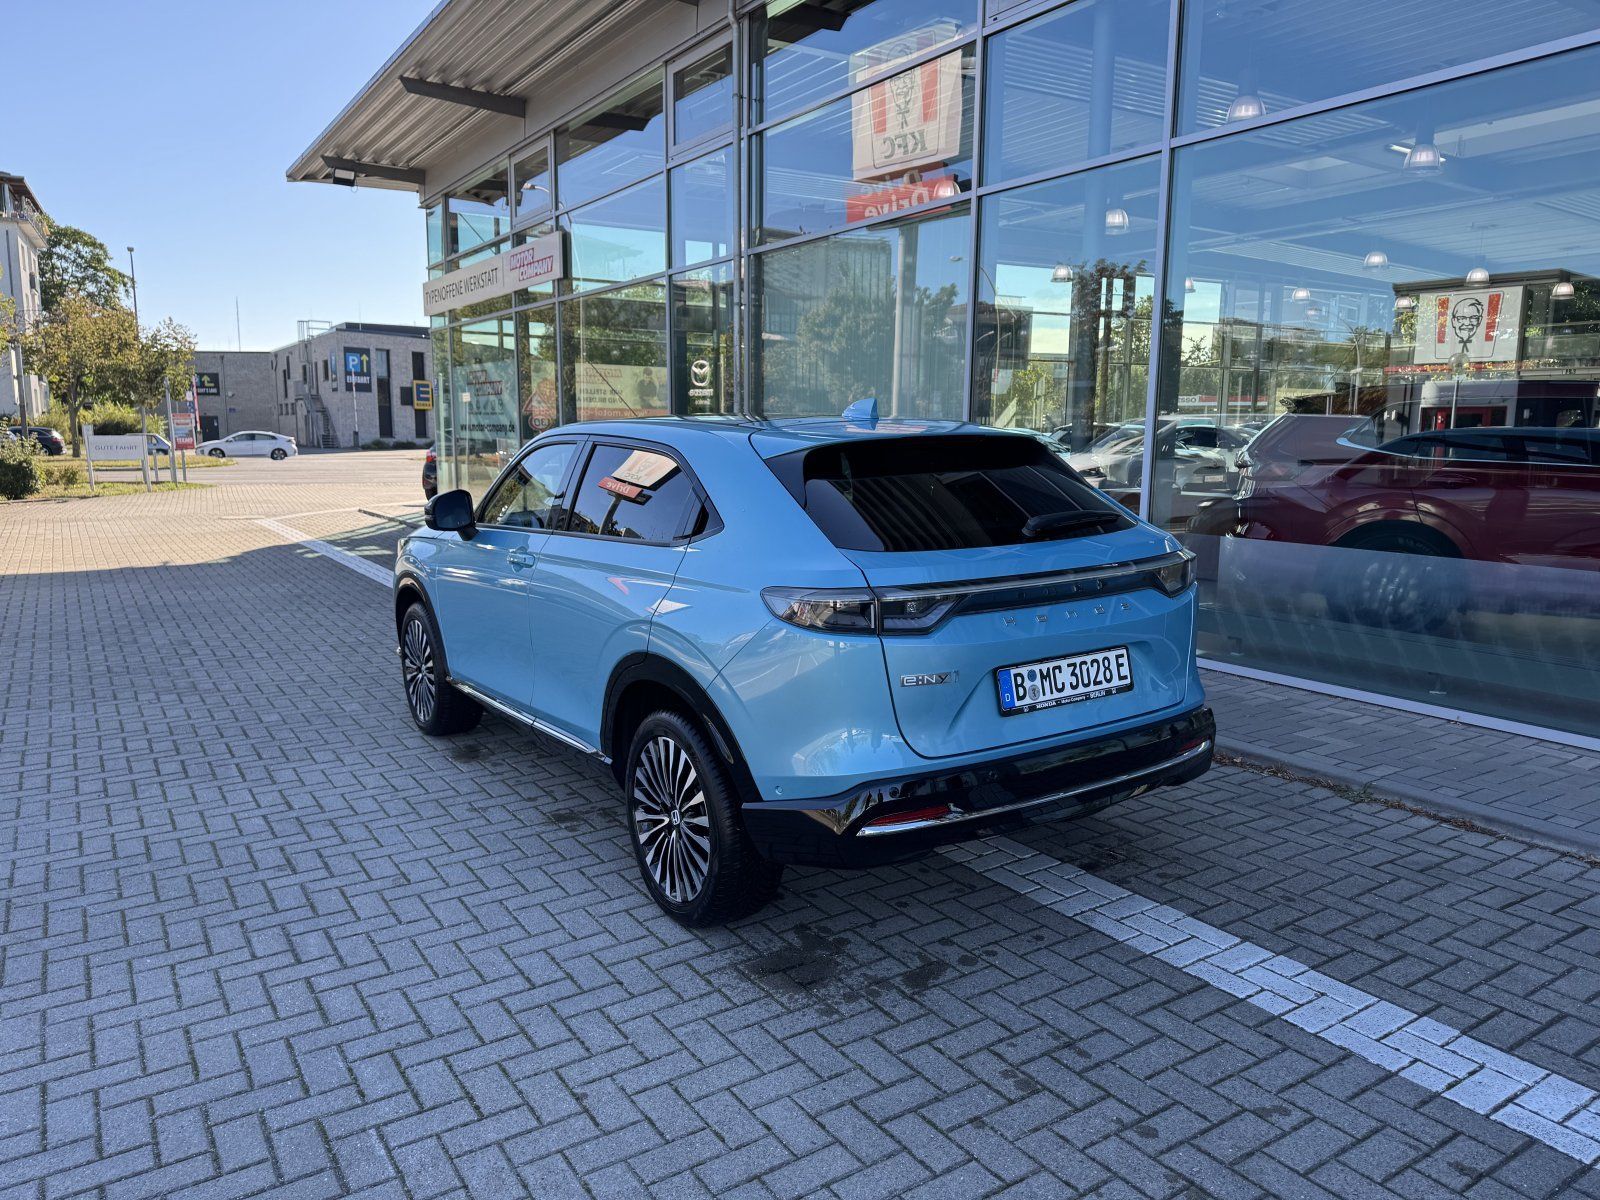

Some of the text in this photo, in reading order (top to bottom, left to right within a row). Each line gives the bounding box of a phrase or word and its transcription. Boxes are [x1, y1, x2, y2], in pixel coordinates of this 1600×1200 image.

[510, 248, 534, 271] MOTOR
[519, 255, 553, 282] COMPANY
[425, 267, 498, 306] TYPENOFFENE WERKSTATT
[349, 356, 358, 370] P
[1013, 672, 1028, 702] B
[1038, 664, 1066, 697] MC
[1005, 693, 1011, 702] D
[1036, 701, 1057, 709] HONDA
[1089, 690, 1106, 699] BERLIN
